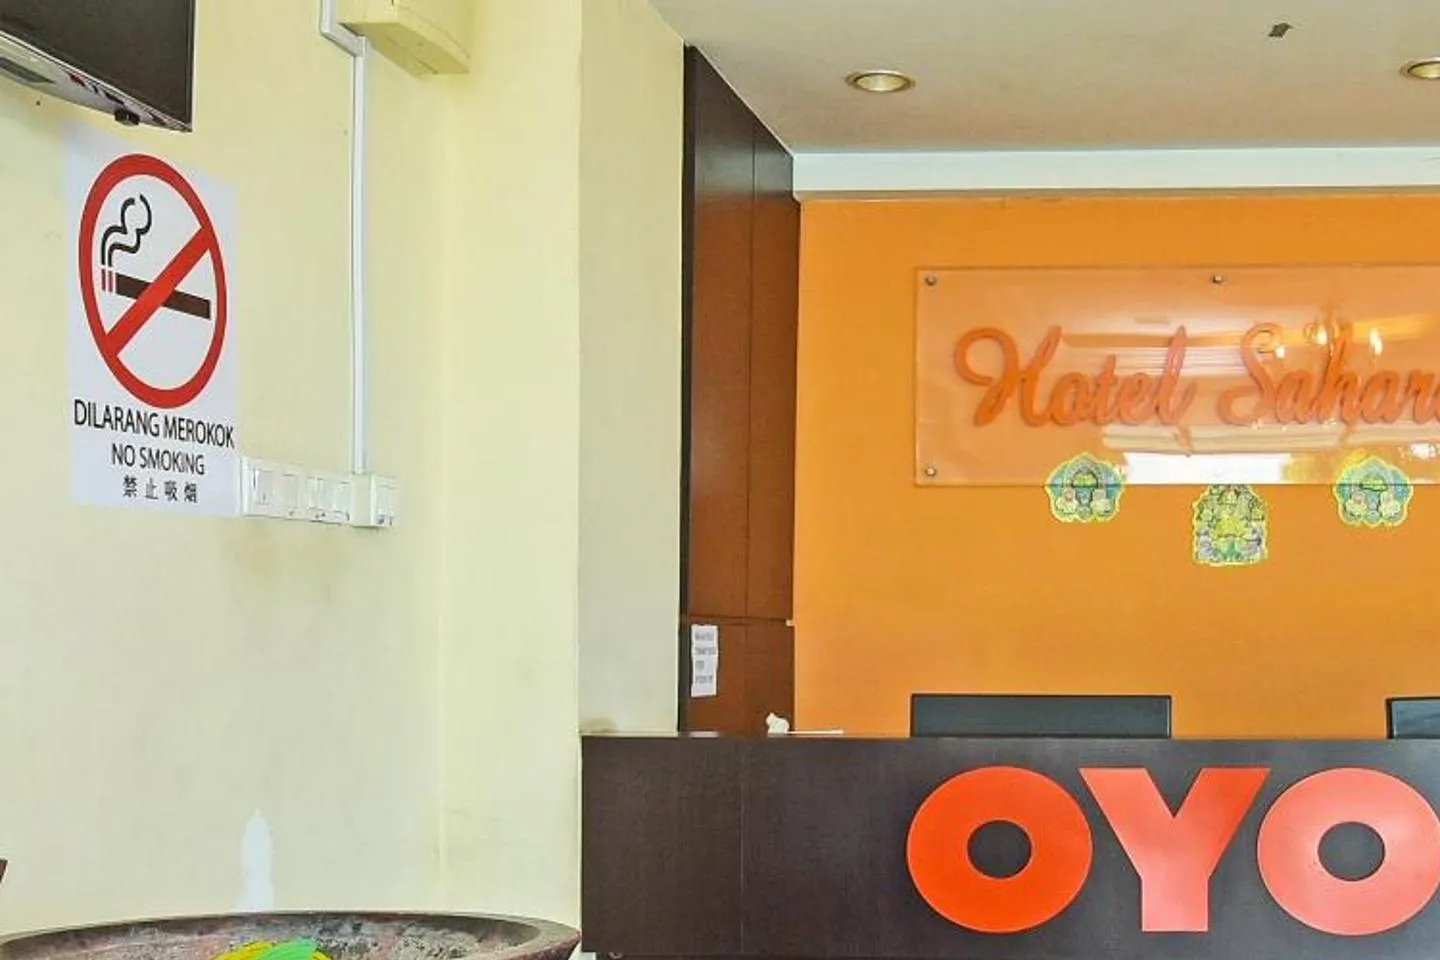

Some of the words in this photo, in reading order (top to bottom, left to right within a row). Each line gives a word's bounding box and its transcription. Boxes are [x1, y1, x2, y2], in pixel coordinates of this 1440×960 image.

[953, 325, 1199, 428] Hotel
[73, 398, 160, 438] DILARANG
[163, 414, 236, 449] MEROKOK
[111, 442, 136, 467] NO
[139, 446, 205, 476] SMOKING
